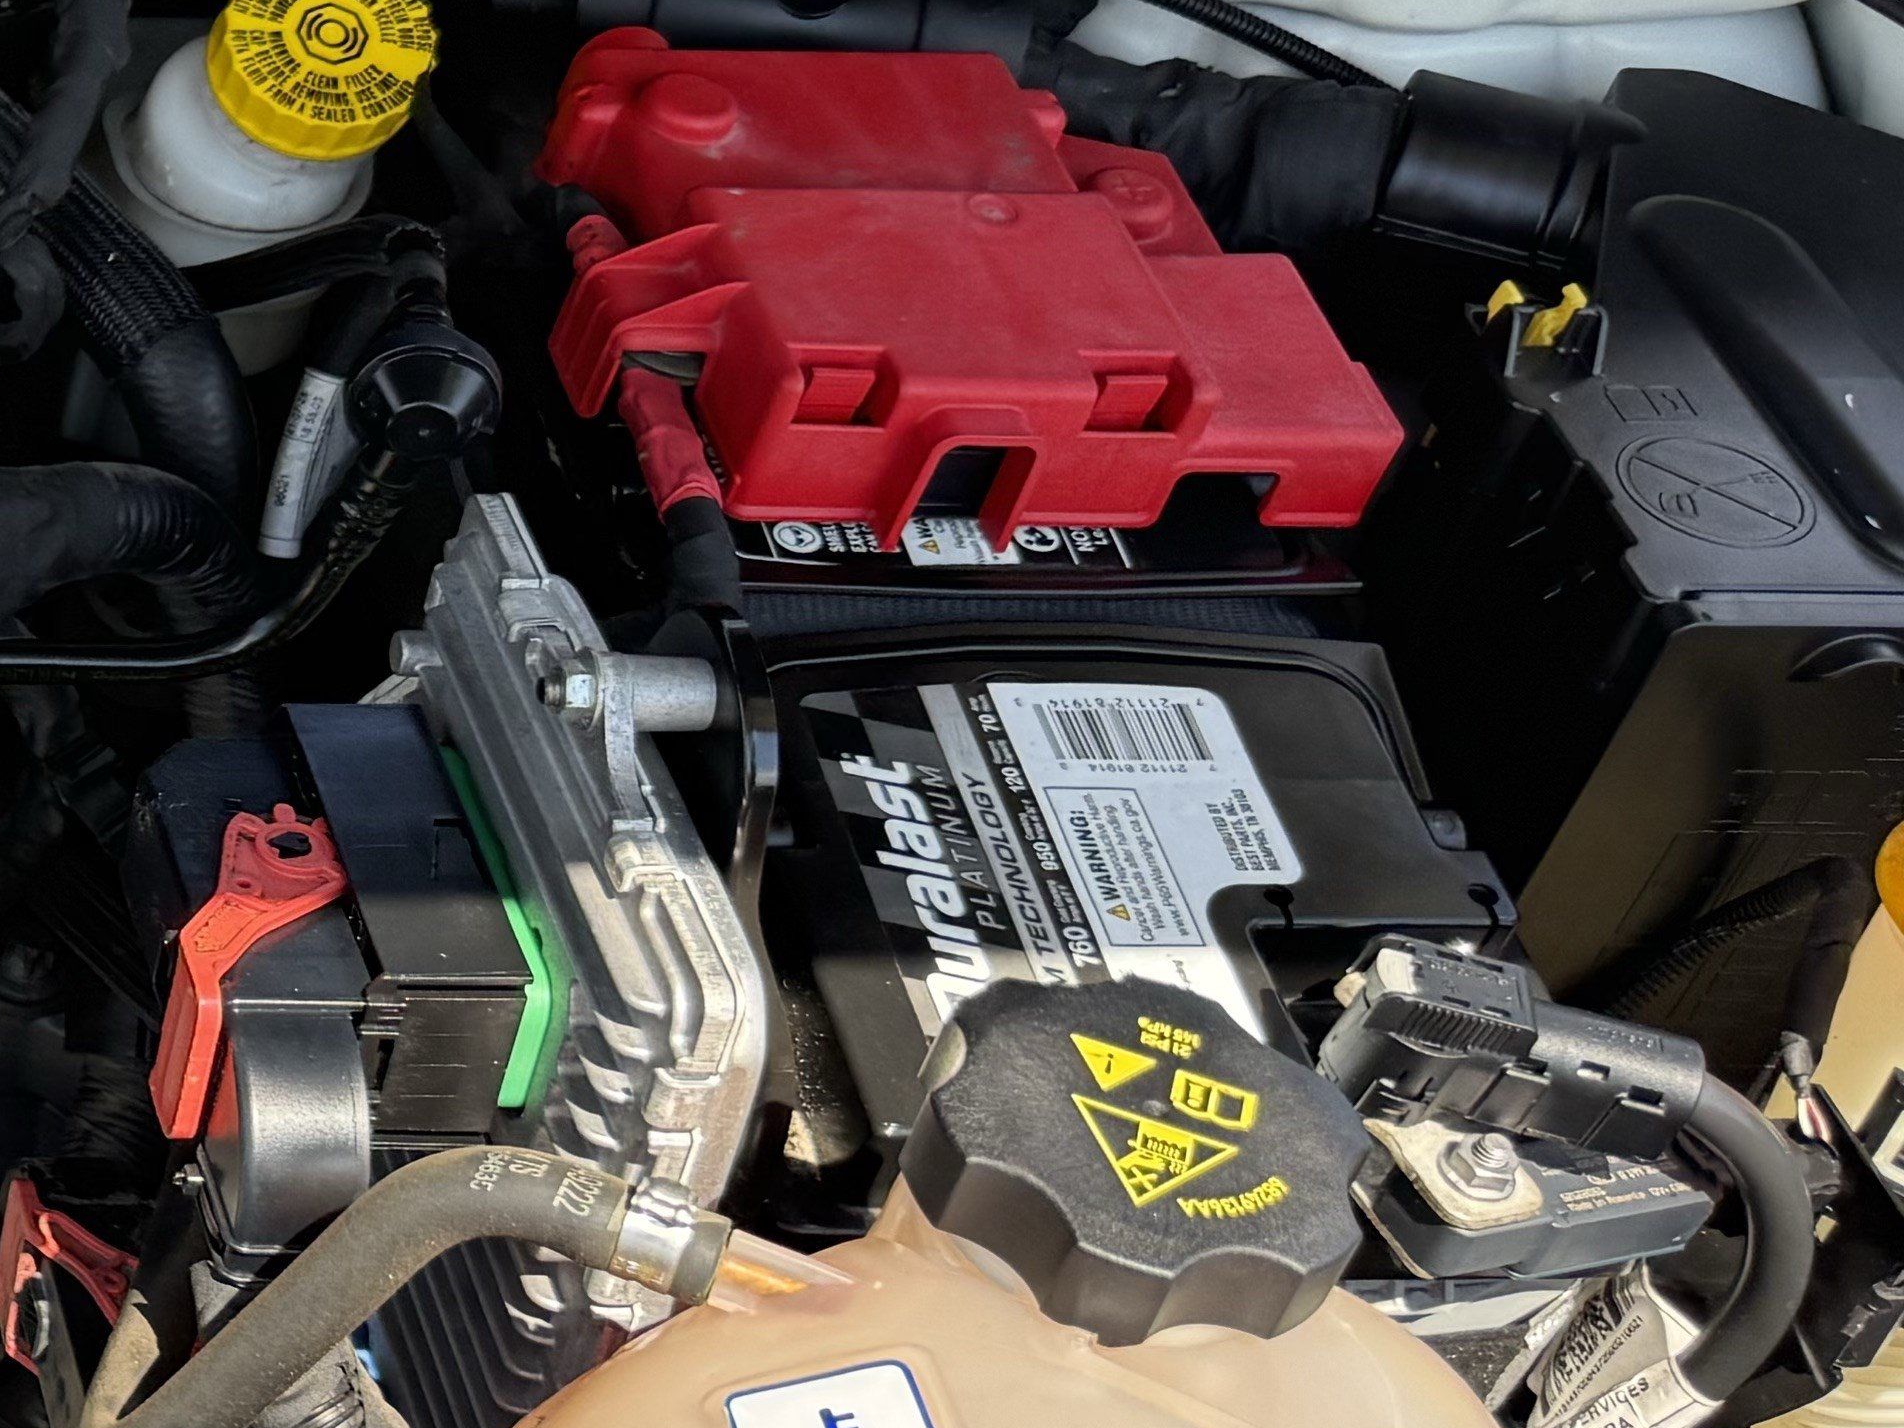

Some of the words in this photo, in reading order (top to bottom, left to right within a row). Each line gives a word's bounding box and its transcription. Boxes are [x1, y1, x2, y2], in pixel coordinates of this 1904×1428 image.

[303, 71, 339, 90] CLEAN
[310, 105, 356, 123] SEALED
[975, 714, 1001, 731] 70
[998, 767, 1028, 792] 120
[1204, 802, 1218, 815] BY
[916, 764, 1005, 932] PLATINUM
[1030, 841, 1061, 870] 950
[1213, 818, 1248, 871] DISTRIBUTED
[962, 772, 1058, 958] TECHNOLOGY
[1241, 849, 1265, 871] BEST
[1124, 887, 1139, 908] and
[1134, 873, 1151, 900] hands
[1145, 901, 1165, 930] Wash
[1058, 926, 1104, 967] 760
